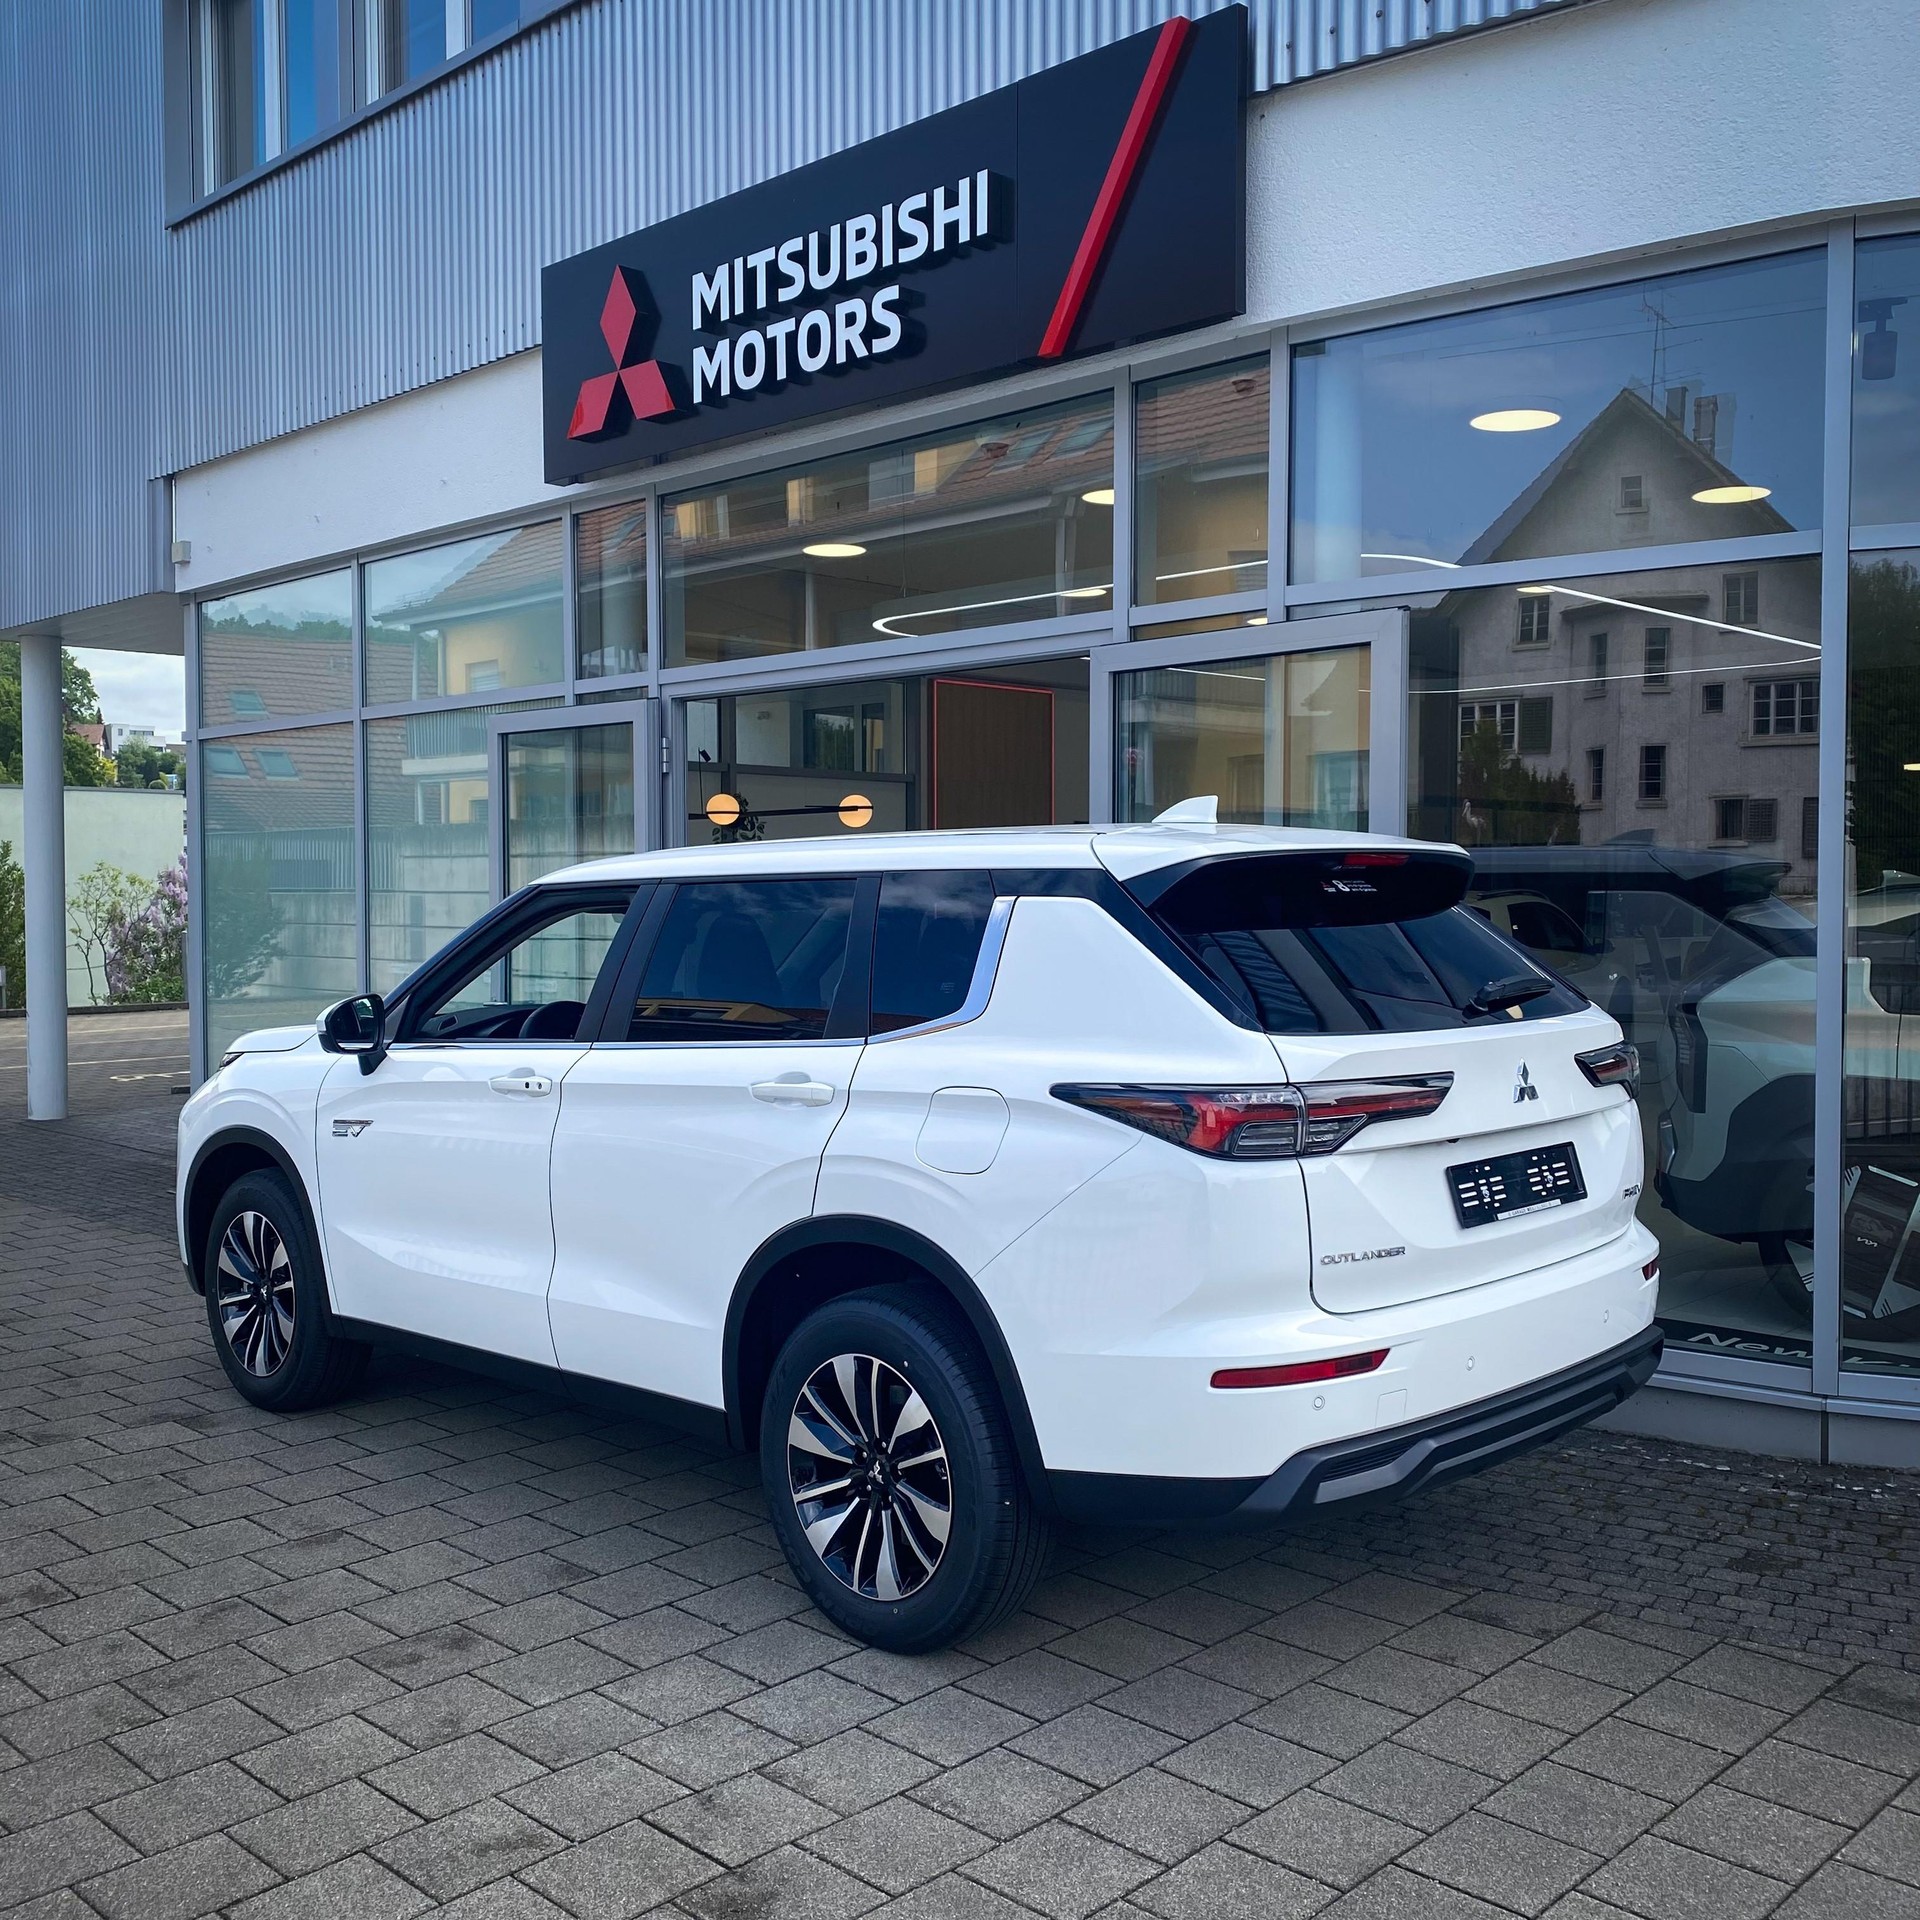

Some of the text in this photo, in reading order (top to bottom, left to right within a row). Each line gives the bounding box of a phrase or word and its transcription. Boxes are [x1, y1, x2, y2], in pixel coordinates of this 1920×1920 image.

[692, 168, 989, 331] MITSUBISHI
[692, 284, 902, 404] MOTORS
[1321, 1246, 1405, 1265] OUTLANDER
